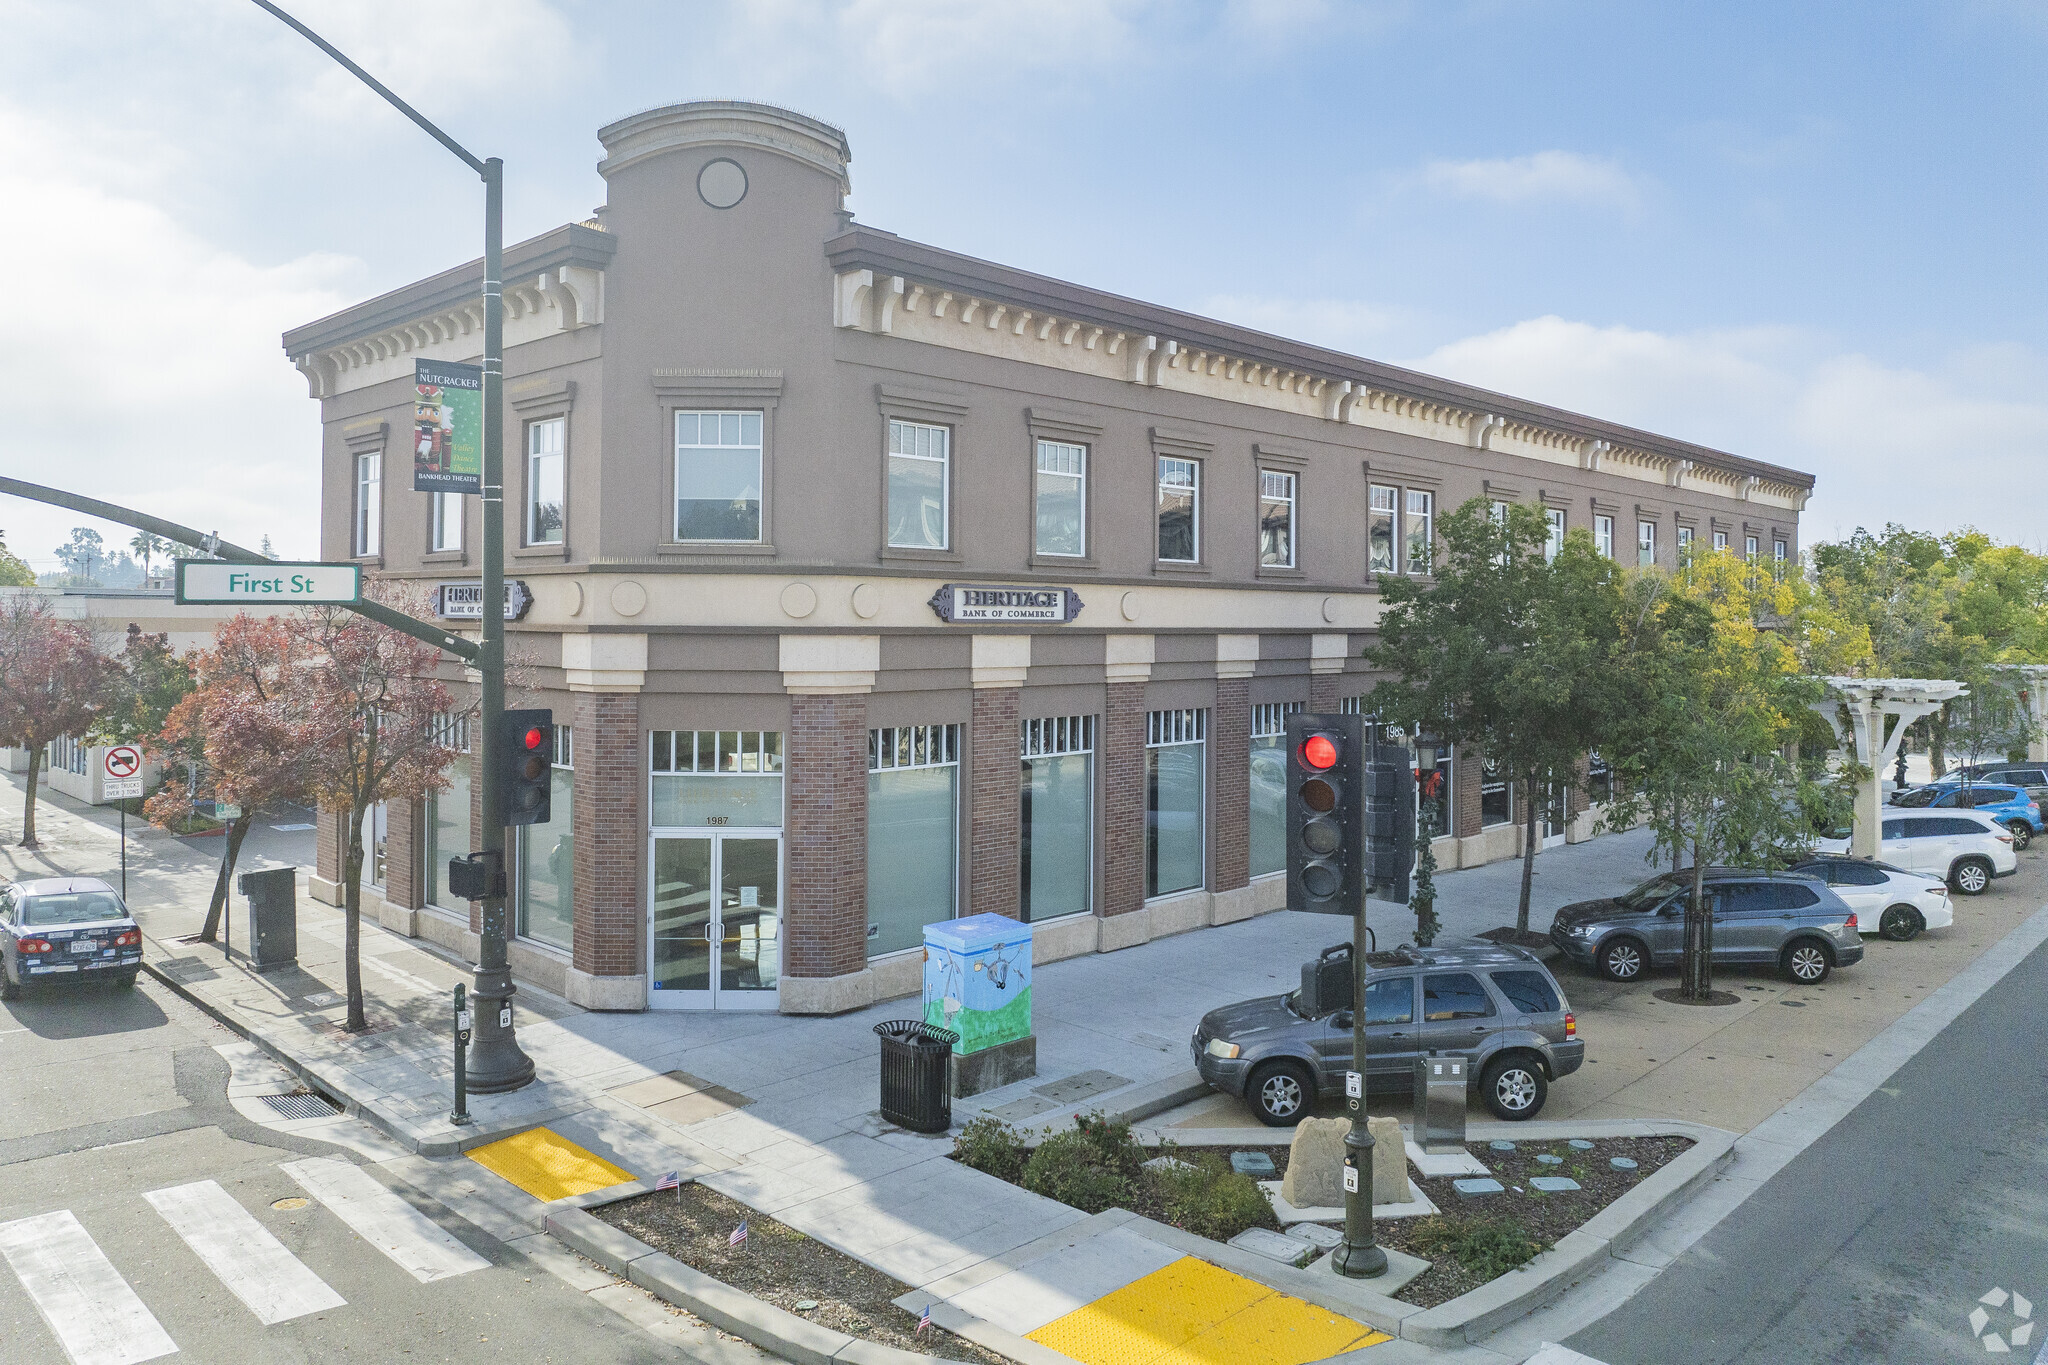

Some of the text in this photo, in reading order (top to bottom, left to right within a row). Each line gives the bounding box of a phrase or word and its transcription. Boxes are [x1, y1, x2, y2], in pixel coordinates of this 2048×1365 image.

[420, 374, 478, 388] NUTCRACKER
[230, 573, 314, 593] First St
[963, 591, 1058, 607] HERITAGE
[706, 816, 728, 825] 1987
